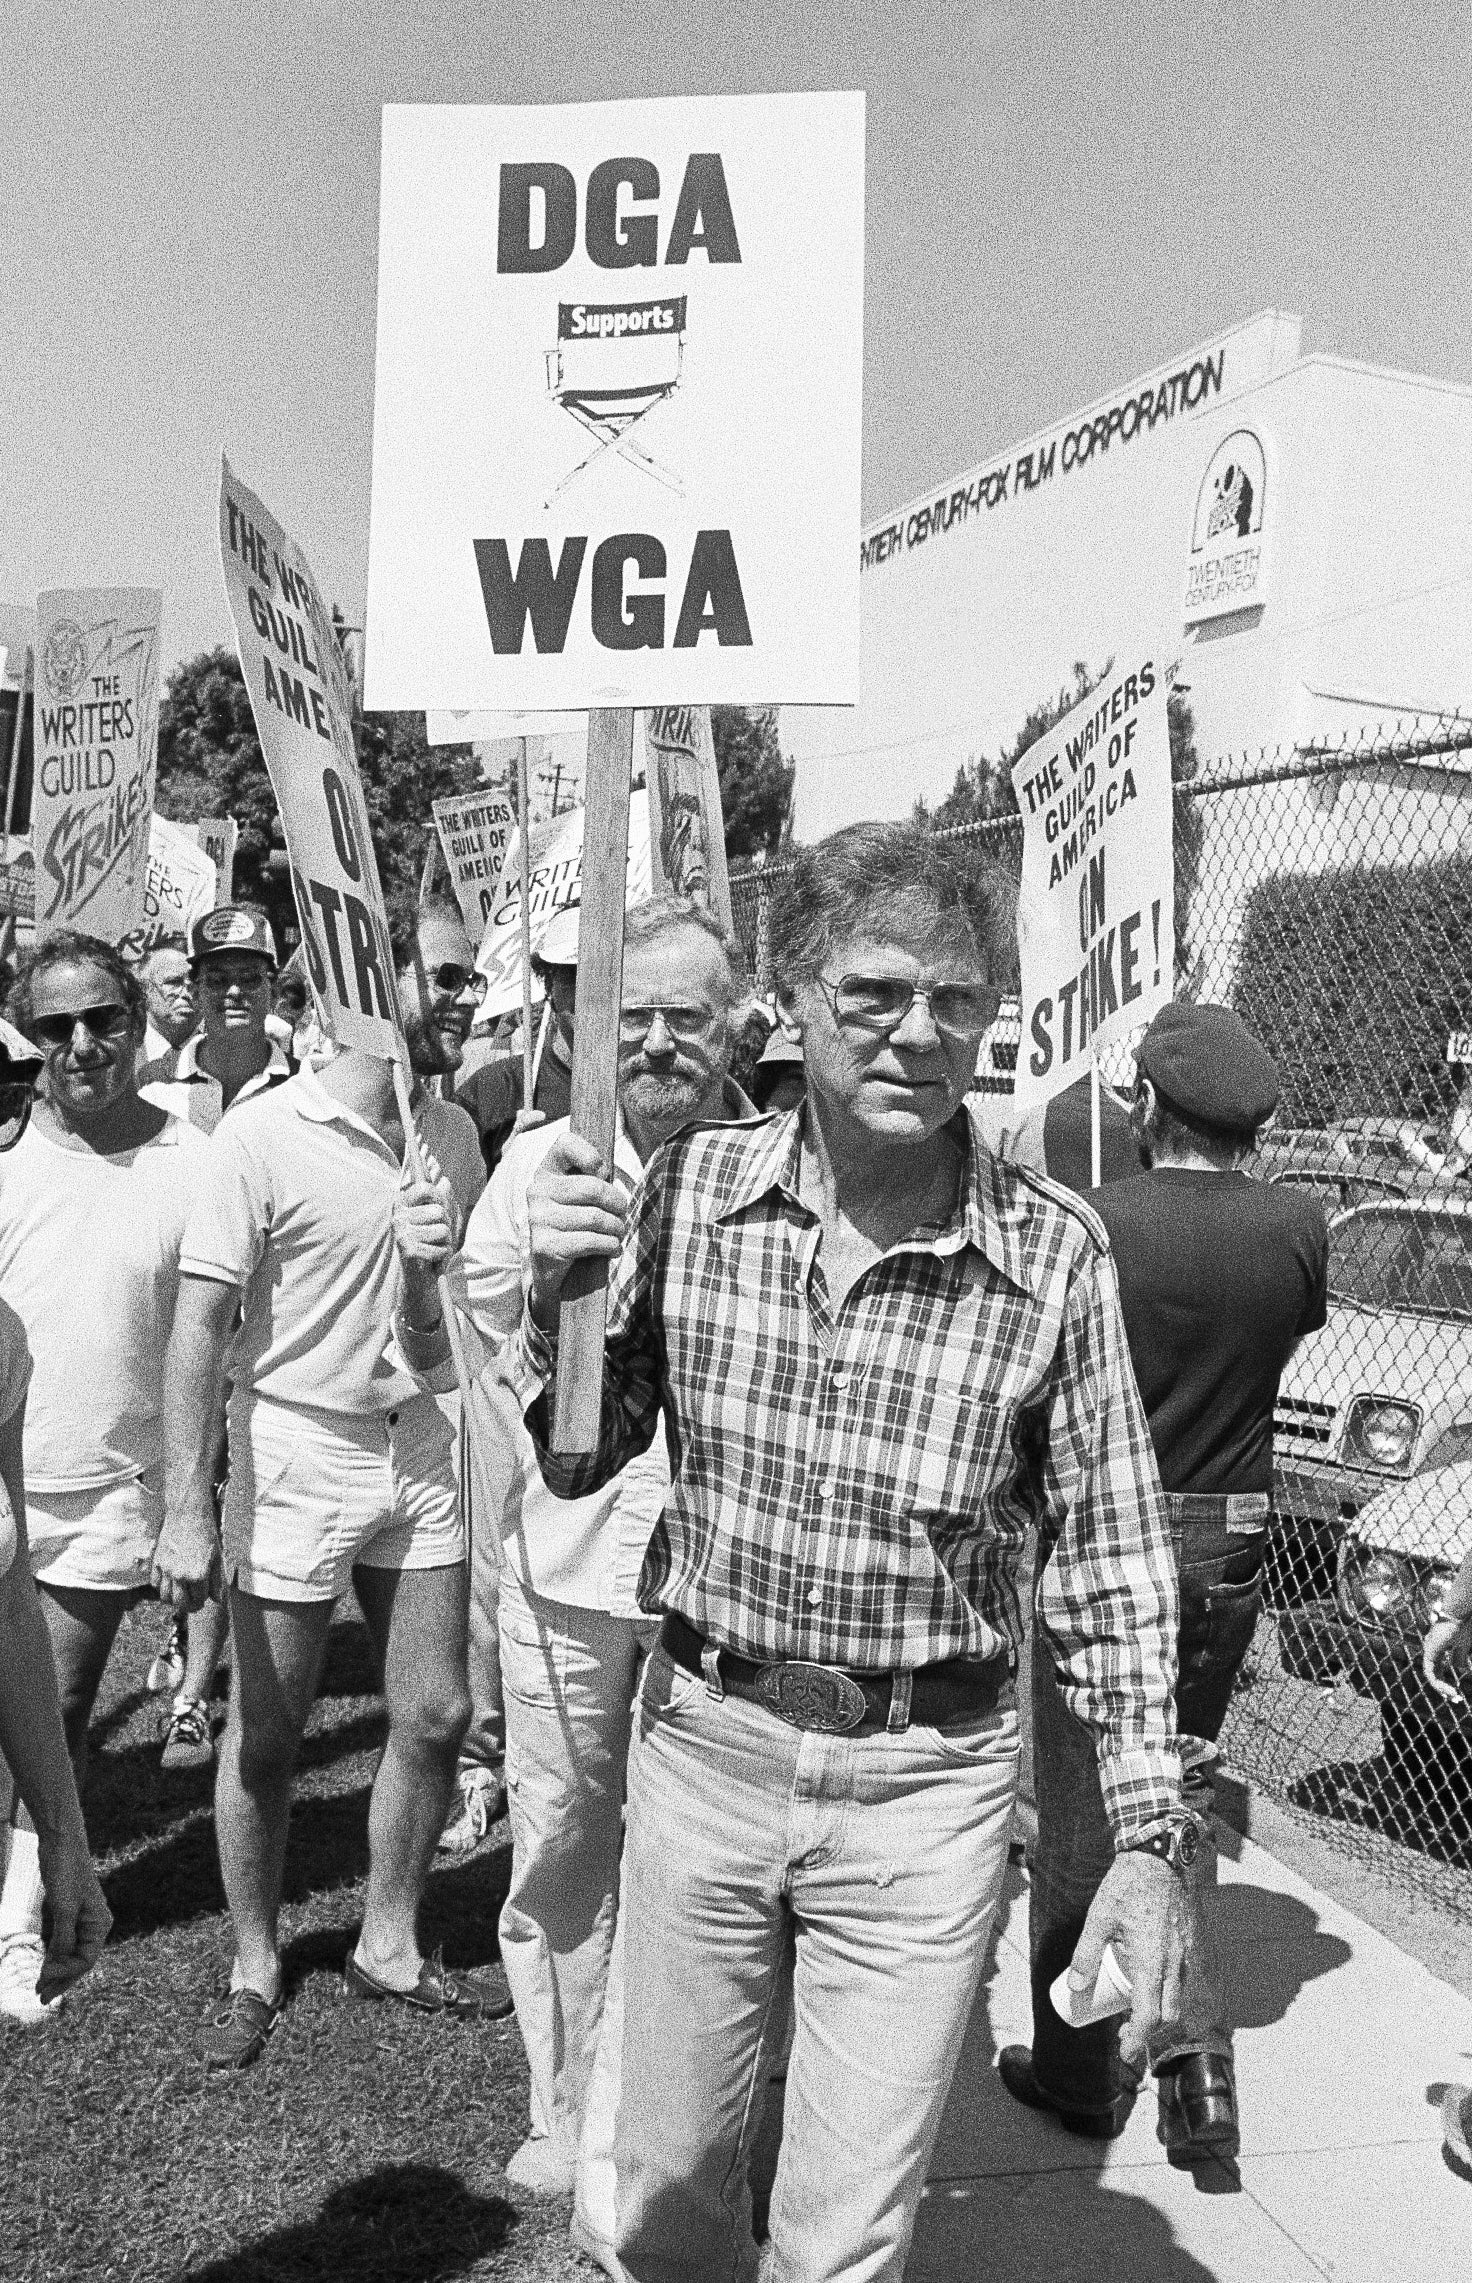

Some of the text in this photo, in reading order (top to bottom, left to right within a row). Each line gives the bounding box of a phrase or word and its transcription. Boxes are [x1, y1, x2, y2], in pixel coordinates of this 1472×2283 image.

[497, 153, 742, 273] DGA
[570, 304, 674, 338] Supports
[860, 524, 904, 572] NTIETH
[1014, 442, 1057, 496] FILM
[1060, 350, 1225, 473] CORPORATION
[227, 497, 271, 588] THE
[472, 529, 753, 654] WGA
[41, 698, 134, 748] WRITERS
[91, 675, 120, 697] THE
[263, 654, 332, 741] AME
[1022, 661, 1155, 814] THE WRITERS
[40, 749, 115, 797] GUILD
[439, 812, 461, 834] THE
[1045, 717, 1138, 843] GUILD OF
[489, 828, 506, 849] OF
[1048, 768, 1137, 891] AMERICA
[292, 868, 392, 1022] STR
[1079, 845, 1106, 953] ON
[1029, 898, 1162, 1077] STRIKE!
